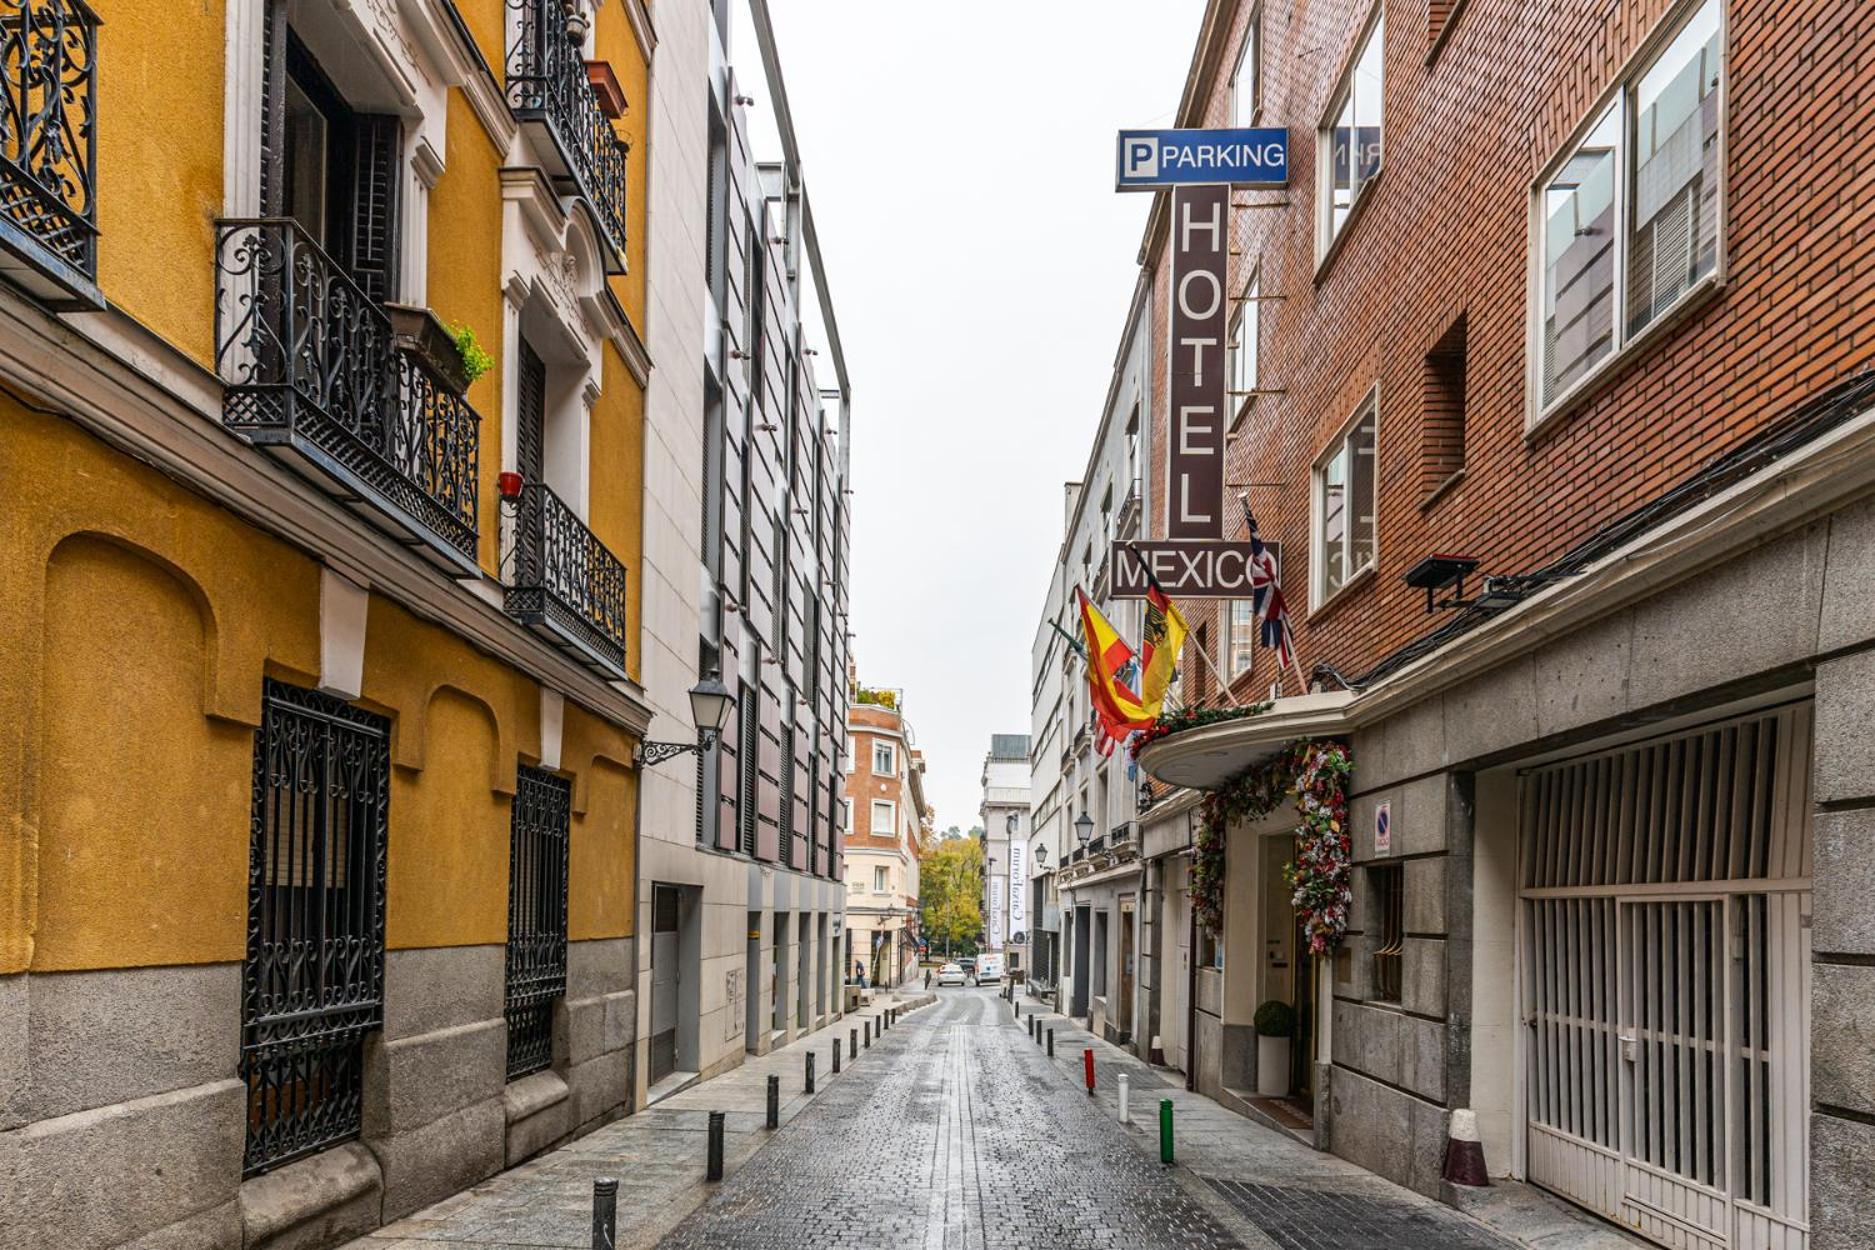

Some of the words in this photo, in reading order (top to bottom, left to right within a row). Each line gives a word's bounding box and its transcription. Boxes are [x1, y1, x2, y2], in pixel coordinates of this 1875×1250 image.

[1162, 143, 1285, 168] PARKING
[1178, 202, 1221, 523] HOTEL
[1116, 550, 1277, 588] MEXICO
